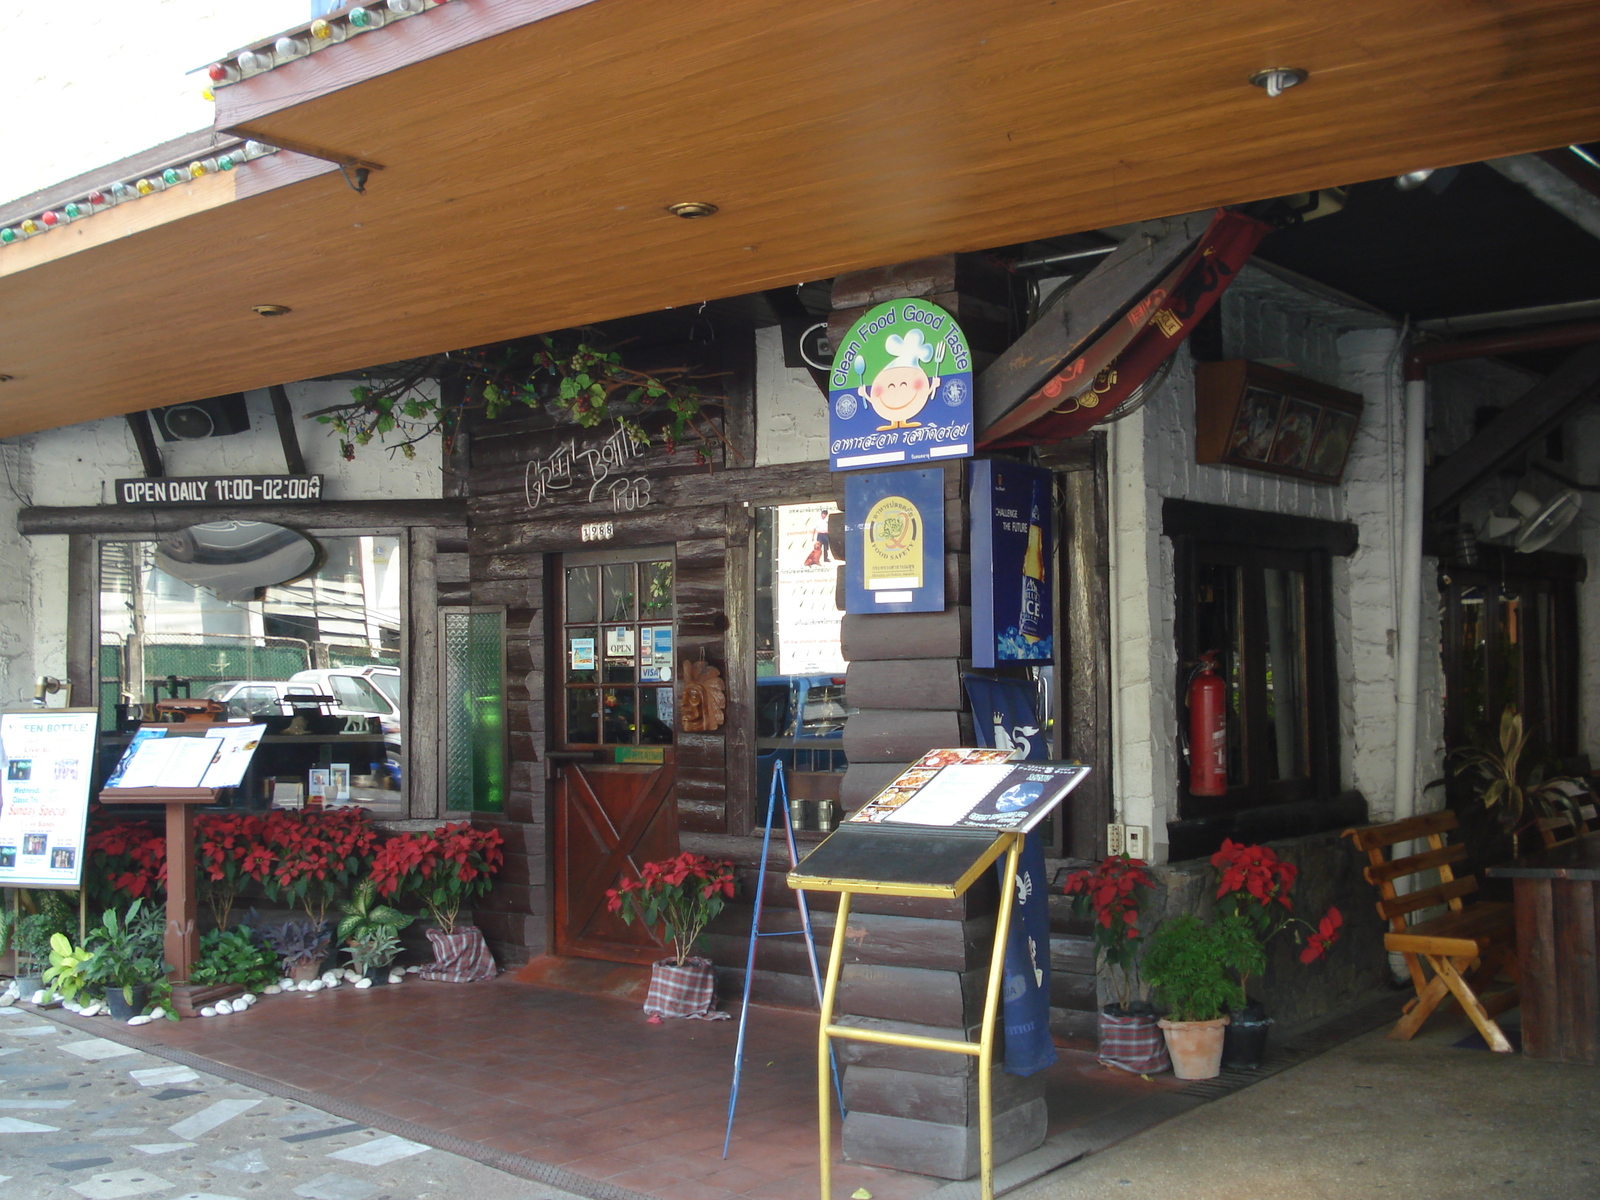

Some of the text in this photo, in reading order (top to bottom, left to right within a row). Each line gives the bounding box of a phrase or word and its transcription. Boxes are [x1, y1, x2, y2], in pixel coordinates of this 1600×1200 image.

[832, 304, 969, 388] Clean Food Good Taste
[831, 432, 899, 455] อาหารสะอาด
[124, 482, 168, 503] OPEN
[169, 481, 209, 502] DAILY
[995, 507, 1018, 519] CHALLENGE
[584, 523, 612, 539] 1988
[872, 543, 914, 560] FOOD SAFETY
[610, 644, 632, 653] OPEN
[642, 668, 659, 677] VISA
